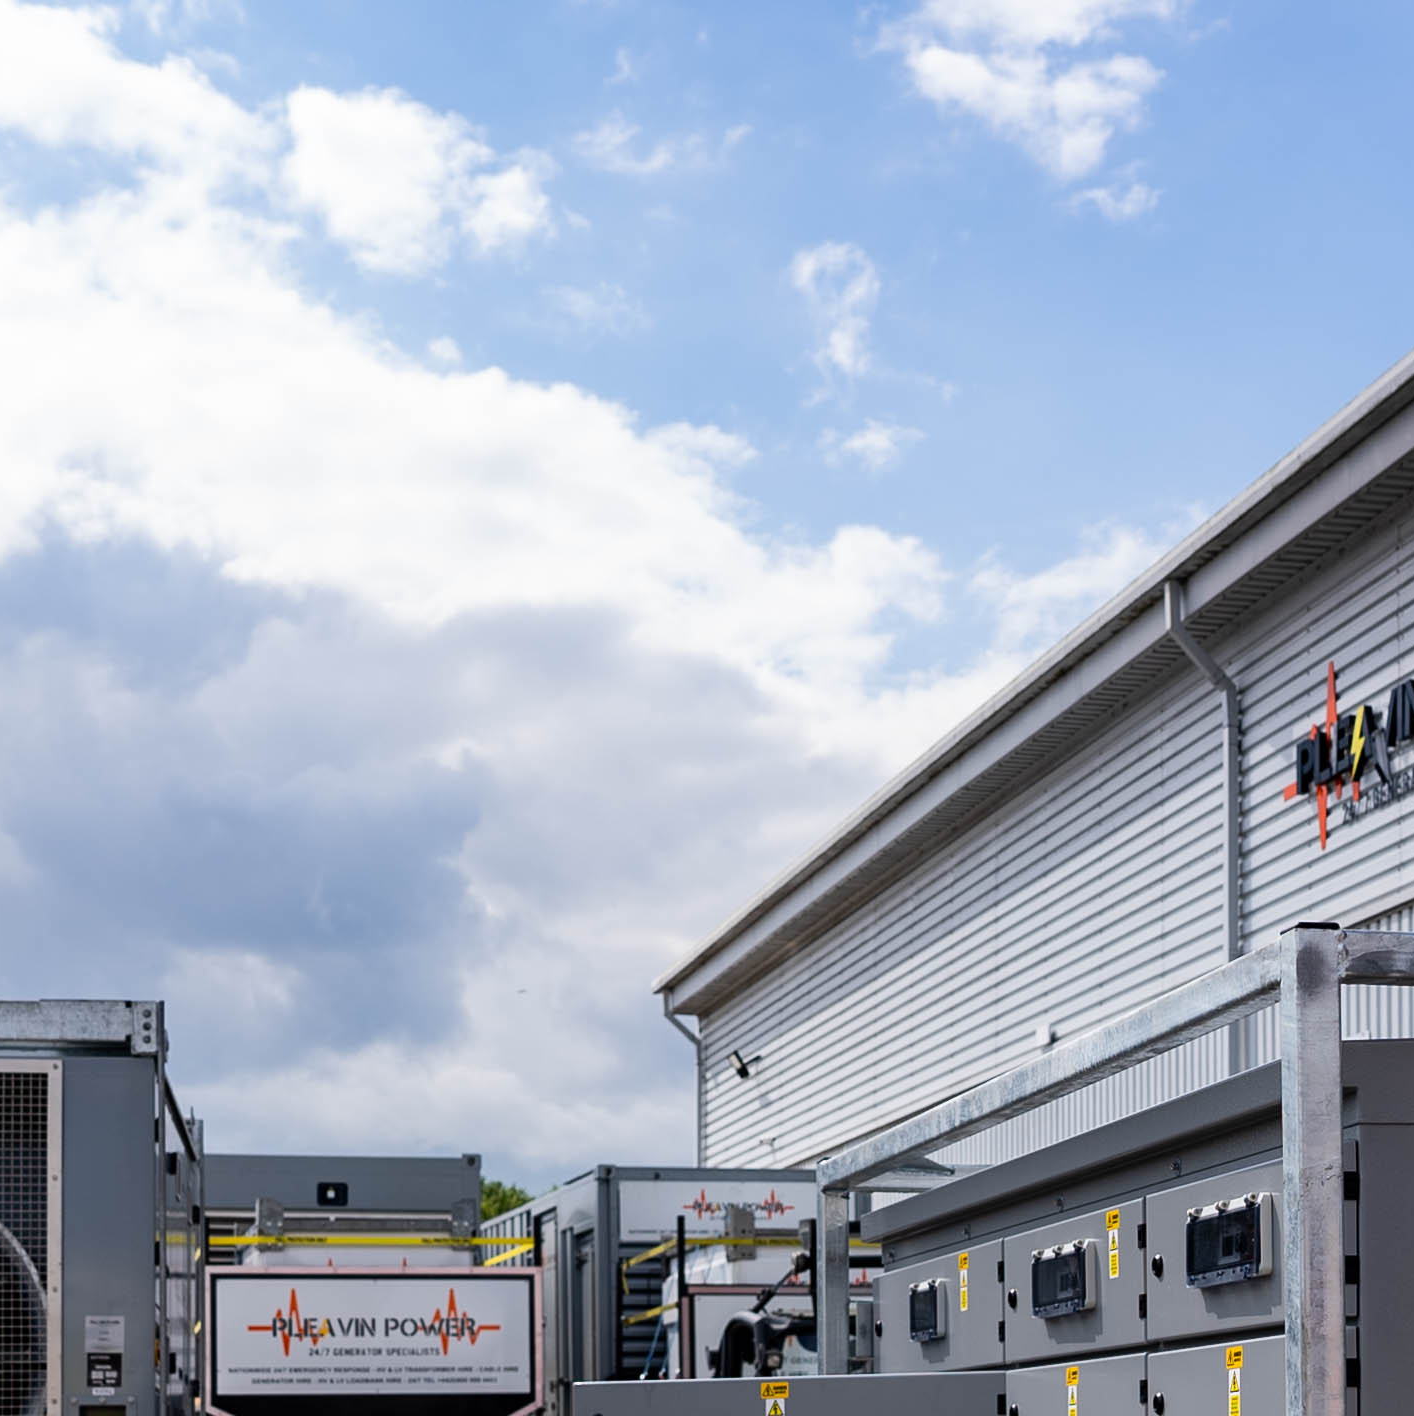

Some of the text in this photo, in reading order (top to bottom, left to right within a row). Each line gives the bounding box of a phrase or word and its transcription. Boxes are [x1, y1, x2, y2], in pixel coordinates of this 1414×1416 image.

[272, 1318, 476, 1337] PLEAVIN POWER
[333, 1347, 383, 1357] GENERATOR
[386, 1347, 440, 1357] SPECIALISTS
